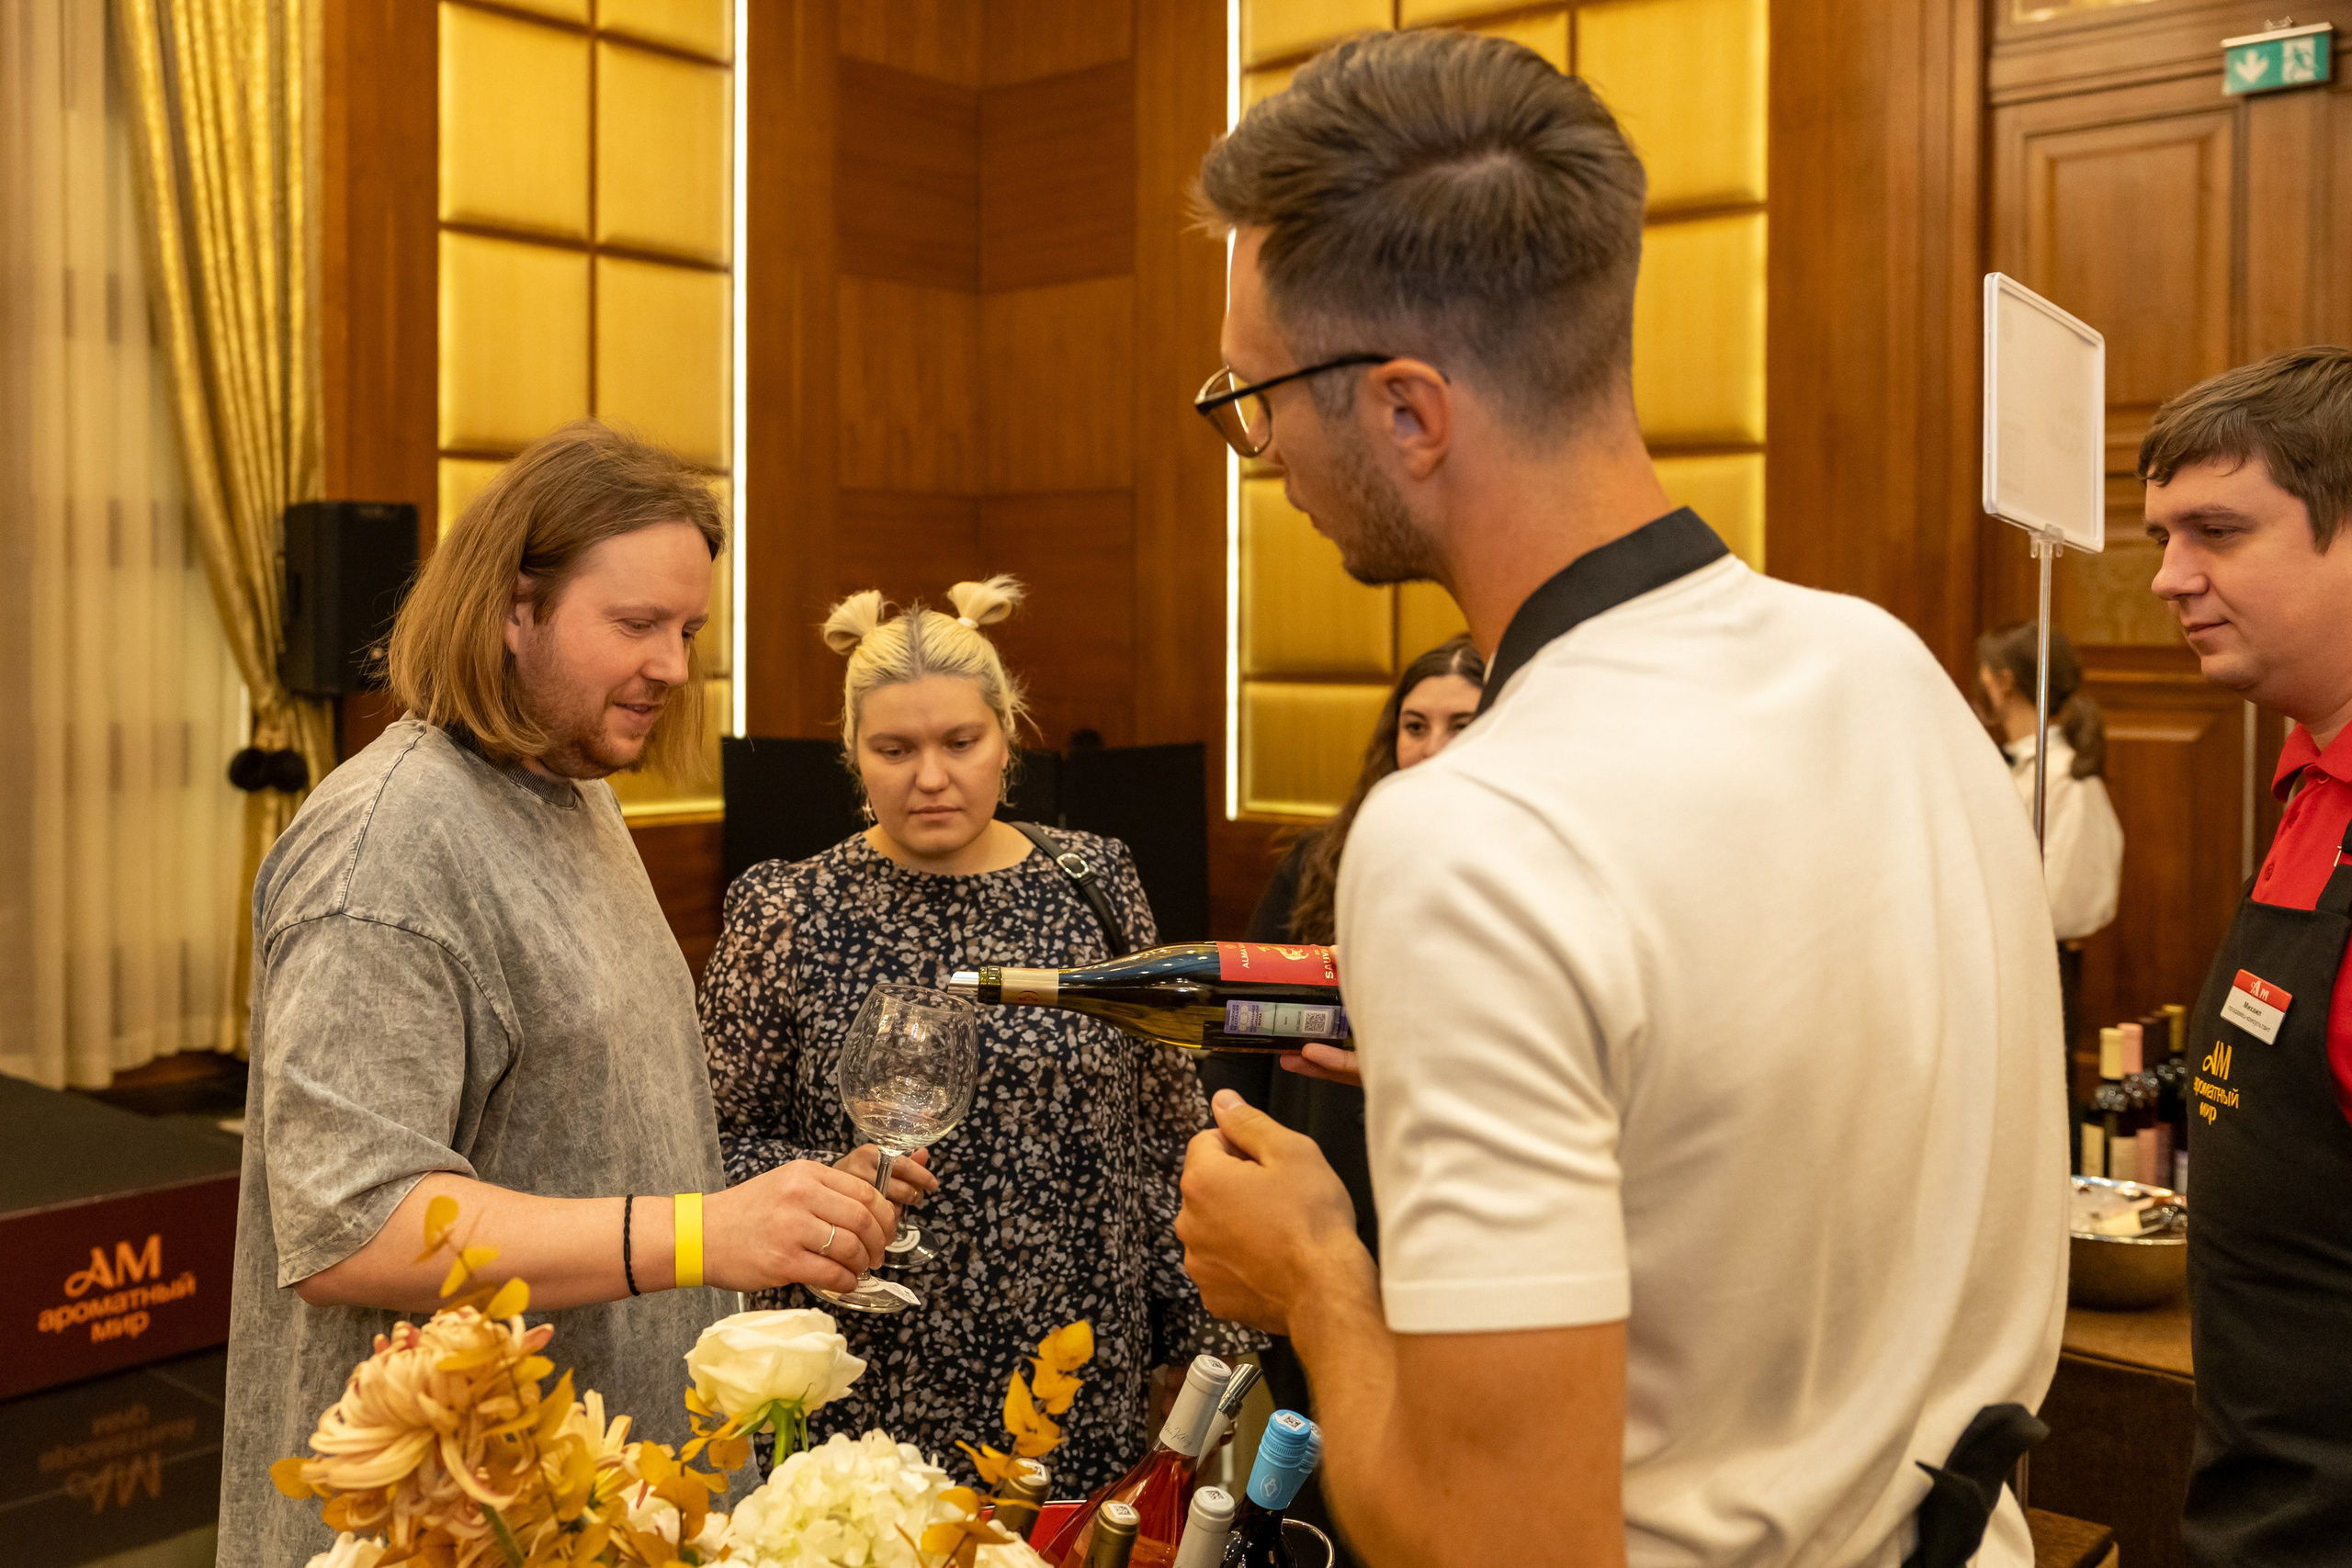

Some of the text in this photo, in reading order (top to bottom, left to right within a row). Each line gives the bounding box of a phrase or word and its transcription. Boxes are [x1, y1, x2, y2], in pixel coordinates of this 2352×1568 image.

[1240, 949, 1250, 969] ALMA
[1321, 948, 1334, 979] SAUVI
[2202, 1040, 2233, 1081] АМ
[2199, 1101, 2218, 1126] мир
[63, 1233, 163, 1298] АМ
[38, 1271, 197, 1334] ароматный
[90, 1311, 151, 1344] мир
